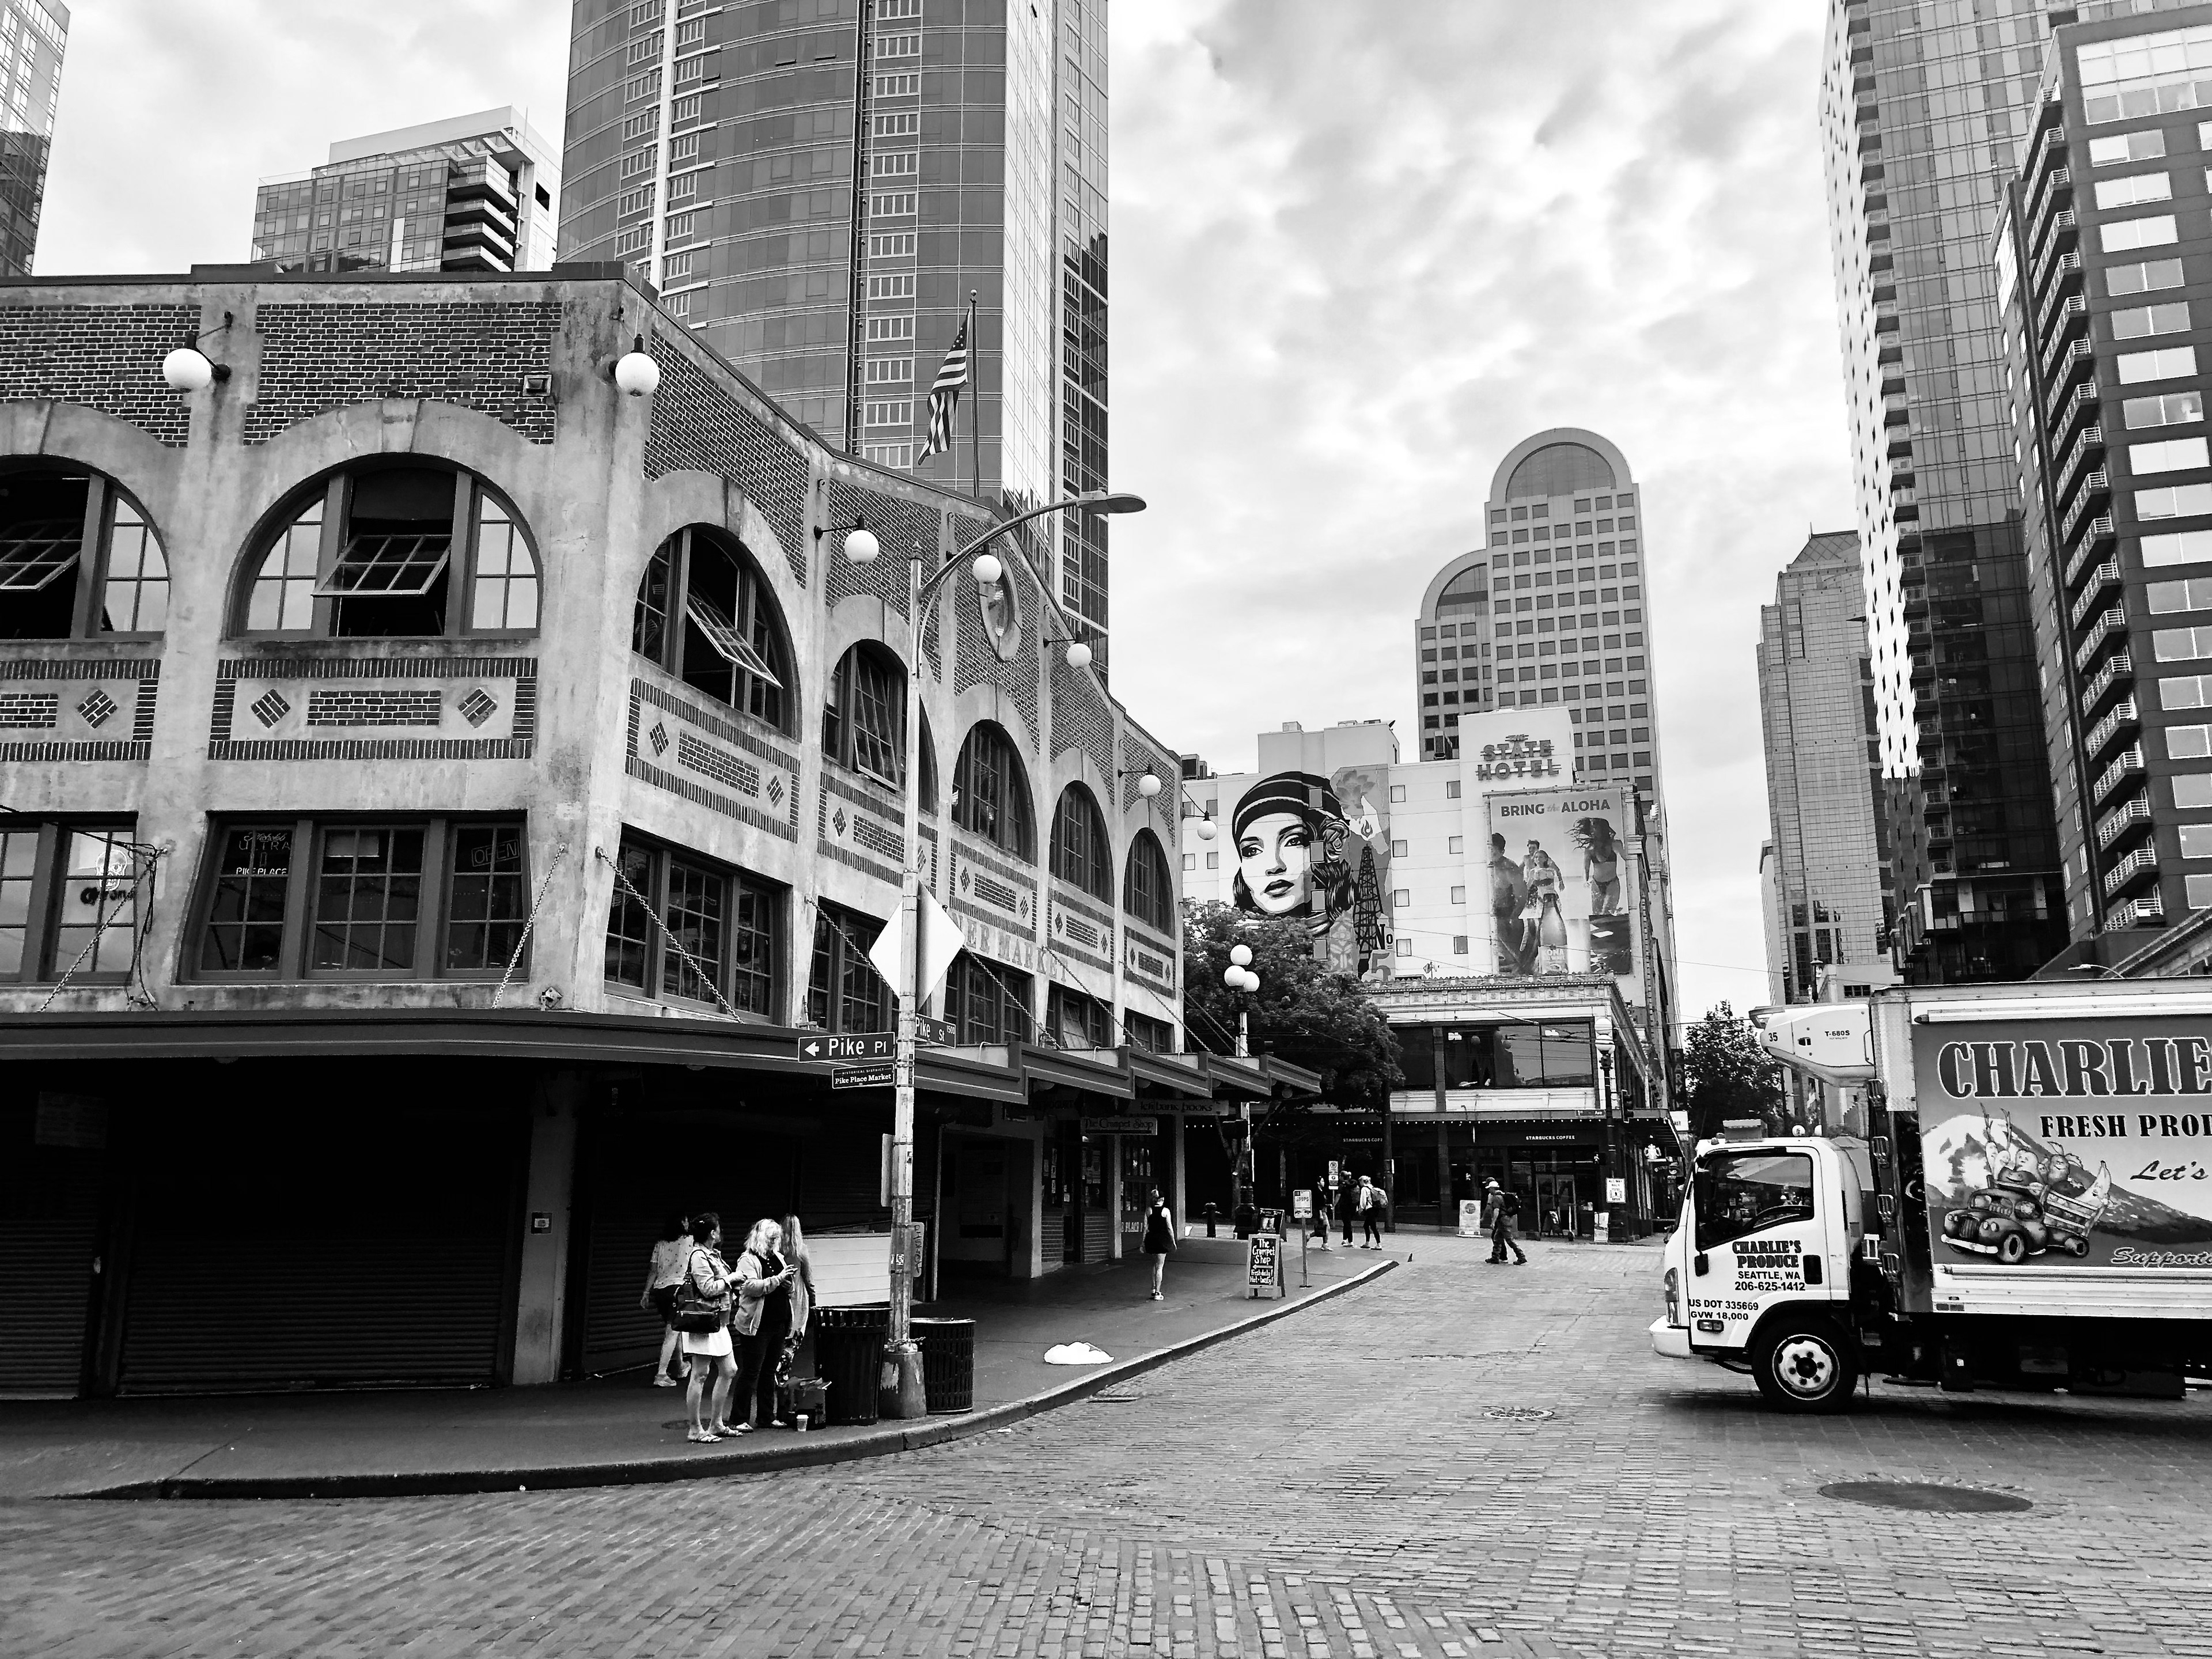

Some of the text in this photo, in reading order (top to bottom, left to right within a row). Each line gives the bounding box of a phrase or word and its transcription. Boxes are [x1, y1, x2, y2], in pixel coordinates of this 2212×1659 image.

[1483, 740, 1552, 761] STATE
[1477, 759, 1560, 781] HOTEL
[1501, 804, 1545, 817] BRING
[1561, 799, 1611, 813] ALOHA
[475, 842, 517, 863] OPEN
[998, 929, 1068, 982] MARKET
[915, 1016, 945, 1042] Pike St
[1768, 1032, 1778, 1041] 35
[828, 1037, 887, 1056] Pike Pl
[868, 1073, 892, 1081] Market
[1674, 1052, 1683, 1094] PARK
[1181, 1102, 1213, 1112] books
[1099, 1118, 1130, 1130] Crumpet
[1133, 1118, 1154, 1130] Shop
[2040, 1114, 2128, 1138] FRESH
[2130, 1160, 2209, 1181] Let's
[1257, 1238, 1270, 1248] The
[1732, 1240, 1802, 1254] CHARLIE'S
[1252, 1245, 1275, 1256] Crumpet
[1254, 1255, 1271, 1266] Shop
[1737, 1255, 1799, 1268] PRODUCE
[1738, 1271, 1801, 1281] SEATTLE, WA
[1734, 1281, 1806, 1291] 206-625-1412
[1689, 1298, 1759, 1310] US DOT 335669
[1690, 1311, 1749, 1321] GVW 18,000
